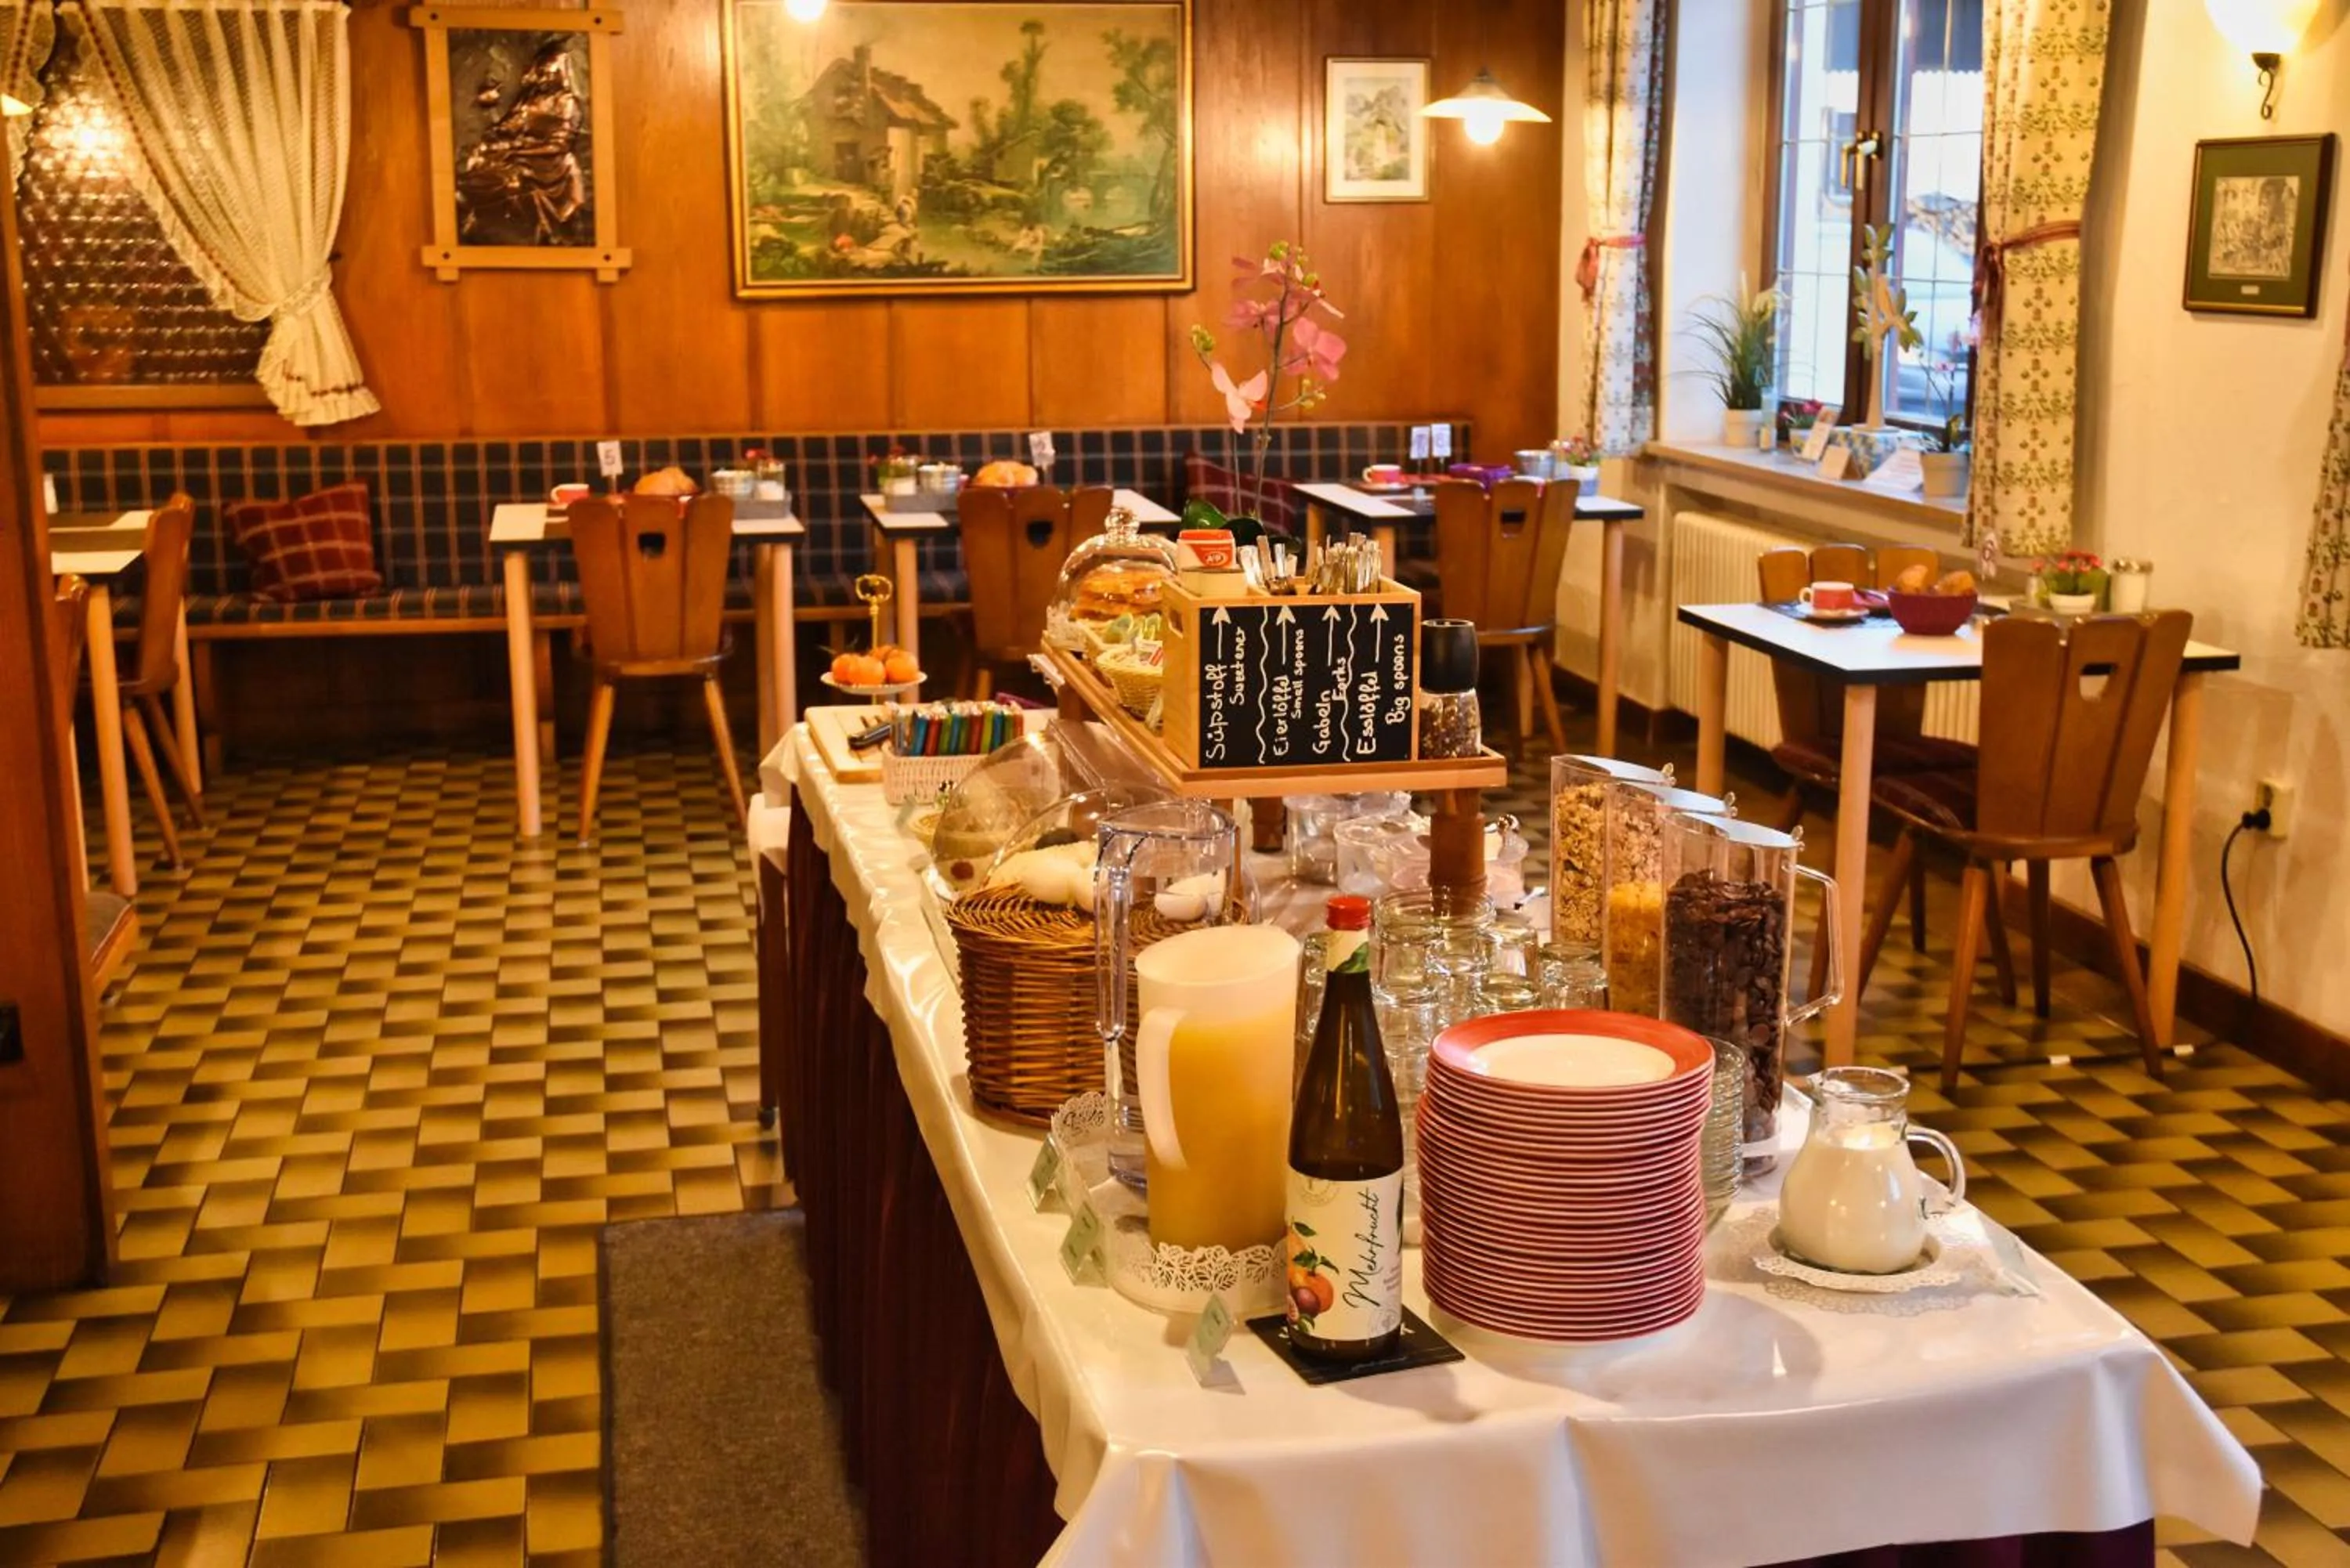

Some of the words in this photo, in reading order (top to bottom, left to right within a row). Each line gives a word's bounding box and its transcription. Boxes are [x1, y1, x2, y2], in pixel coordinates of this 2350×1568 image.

[1229, 626, 1246, 706] Sweetener
[1293, 628, 1308, 676] spoons
[1393, 634, 1409, 690] spoons
[1271, 674, 1292, 756] Eierlöffel
[1290, 679, 1303, 719] Small
[1312, 689, 1332, 754] Gabeln
[1356, 670, 1381, 754] Esslöffel
[1384, 696, 1411, 725] Big
[1342, 1187, 1385, 1309] Mehrfrucht
